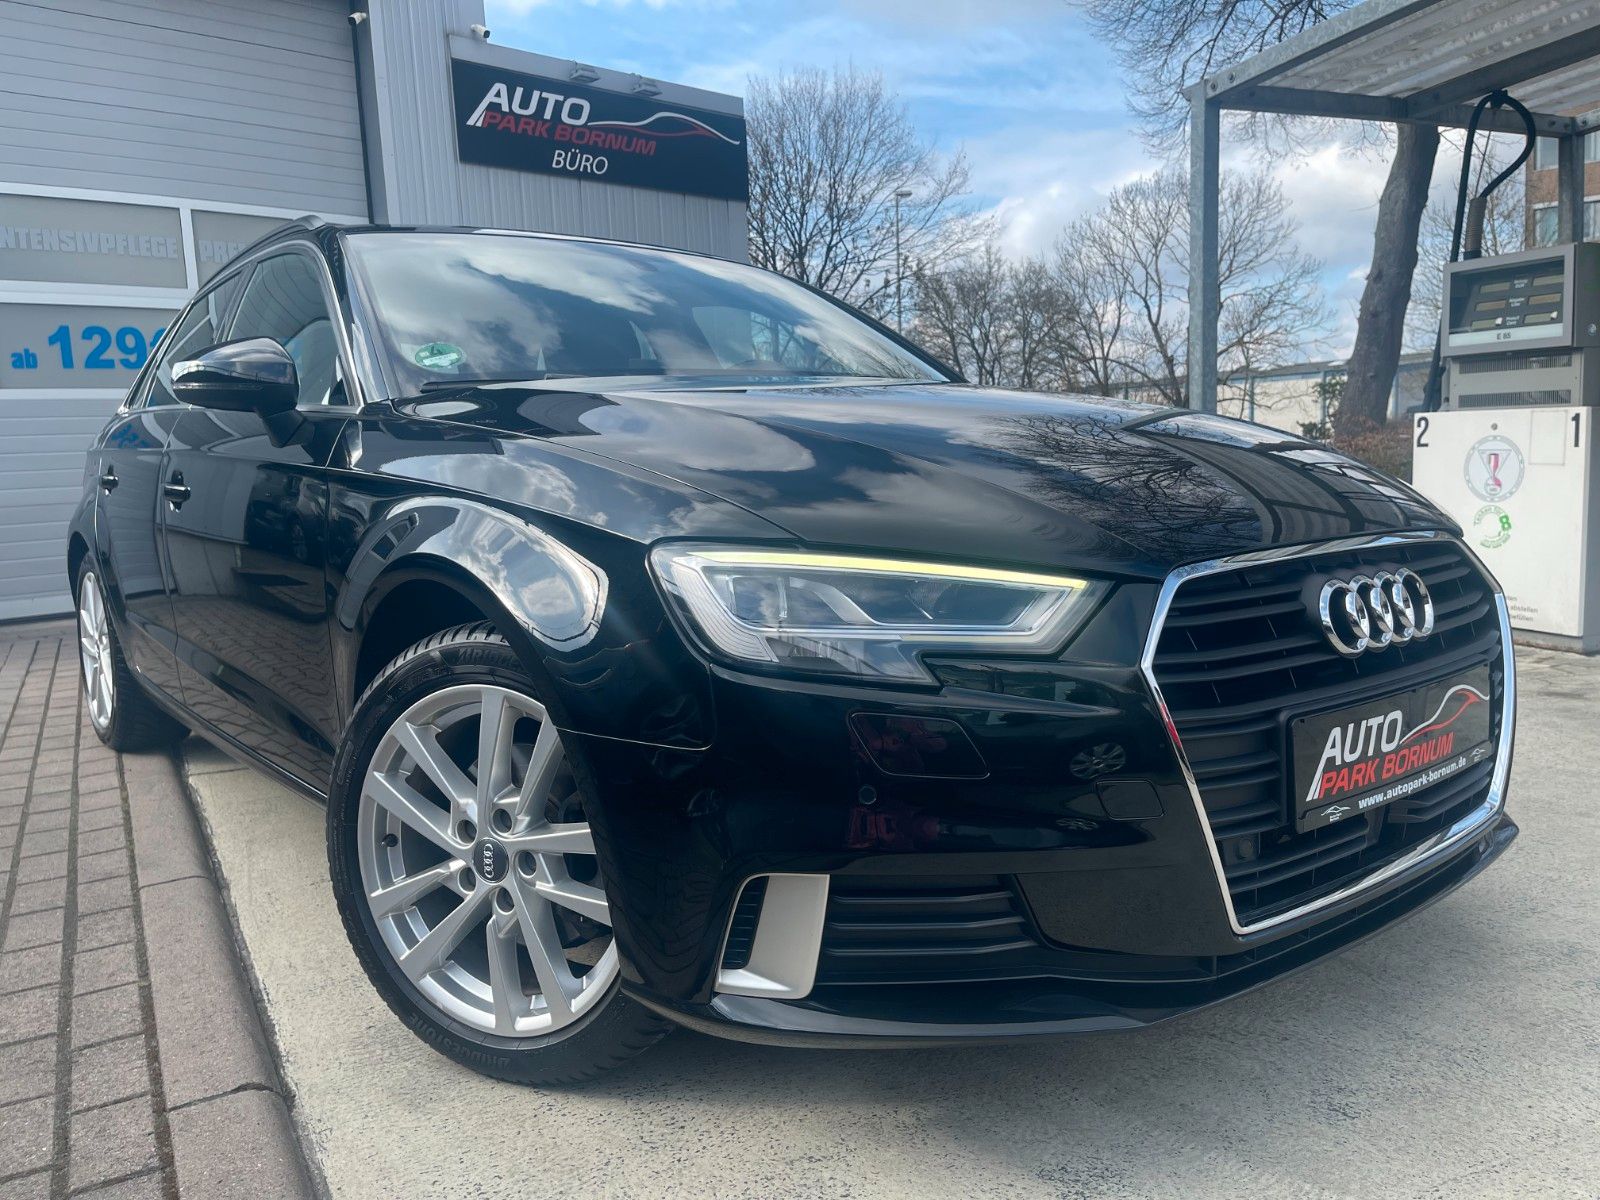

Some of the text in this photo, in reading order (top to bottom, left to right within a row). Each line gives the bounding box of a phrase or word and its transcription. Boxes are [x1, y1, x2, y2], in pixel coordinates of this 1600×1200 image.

[466, 82, 591, 127] AUTO
[482, 110, 657, 156] PARK BORNUM
[552, 148, 608, 175] BÜRO
[11, 348, 38, 369] ab
[1416, 416, 1429, 448] 2
[1571, 412, 1581, 448] 1
[1306, 709, 1403, 801] AUTO
[1318, 731, 1455, 799] PARK BORNUM
[1358, 756, 1467, 809] www.autopark-bornum.de
